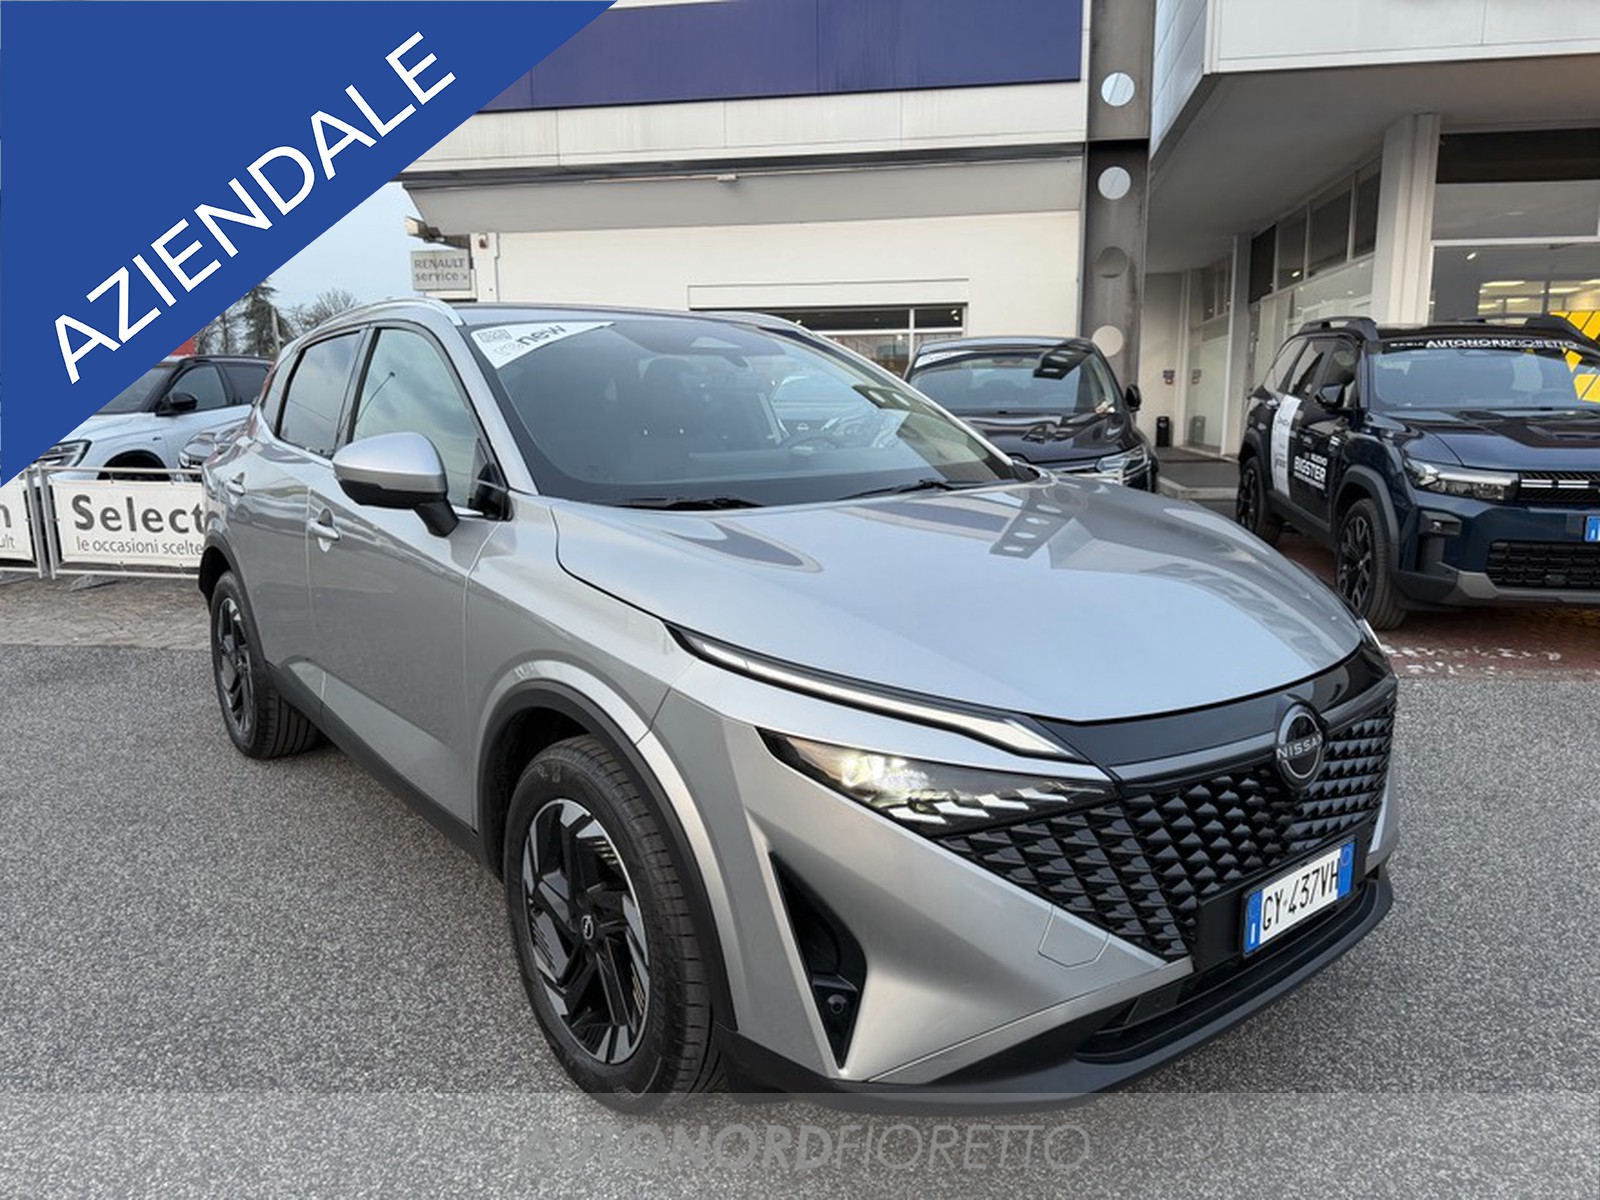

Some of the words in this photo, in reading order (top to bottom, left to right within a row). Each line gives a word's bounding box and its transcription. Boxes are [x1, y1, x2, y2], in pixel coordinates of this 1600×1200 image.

[414, 257, 466, 269] RENAULT
[415, 270, 460, 282] service
[77, 536, 90, 552] le
[93, 538, 159, 553] occasioni
[162, 539, 203, 555] scelte
